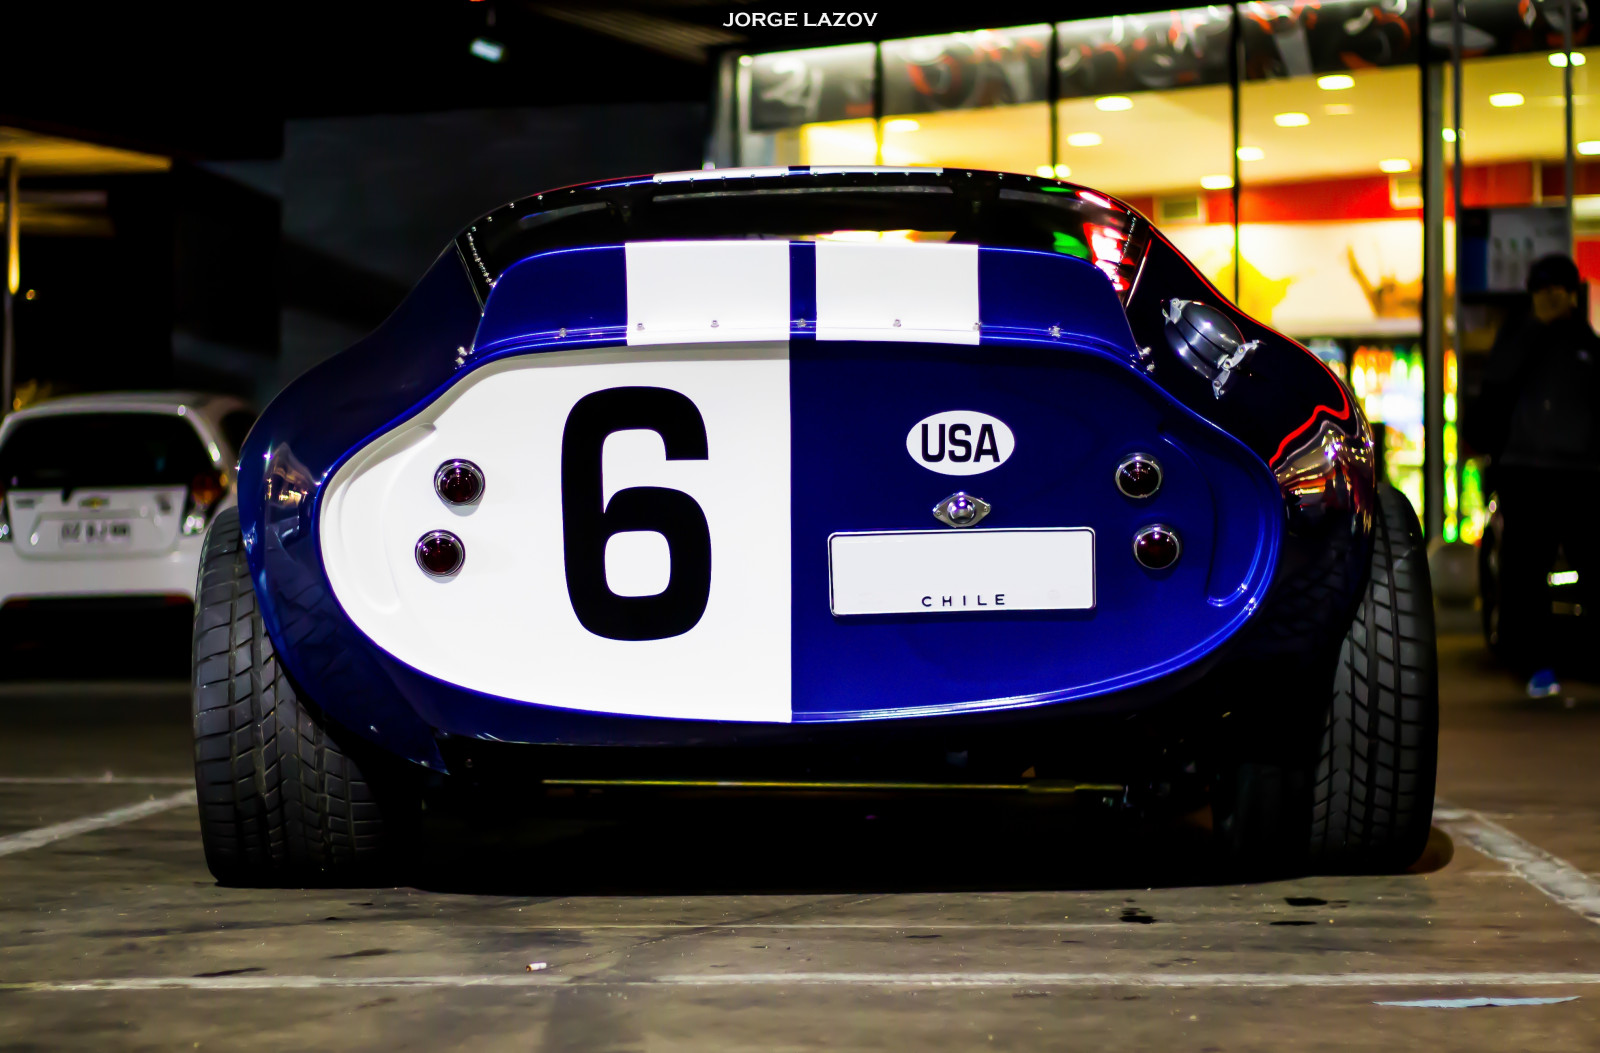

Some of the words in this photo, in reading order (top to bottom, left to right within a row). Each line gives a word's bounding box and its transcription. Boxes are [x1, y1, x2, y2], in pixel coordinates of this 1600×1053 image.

[921, 423, 1001, 463] USA
[561, 385, 712, 642] 6
[921, 593, 1006, 608] CHILE
